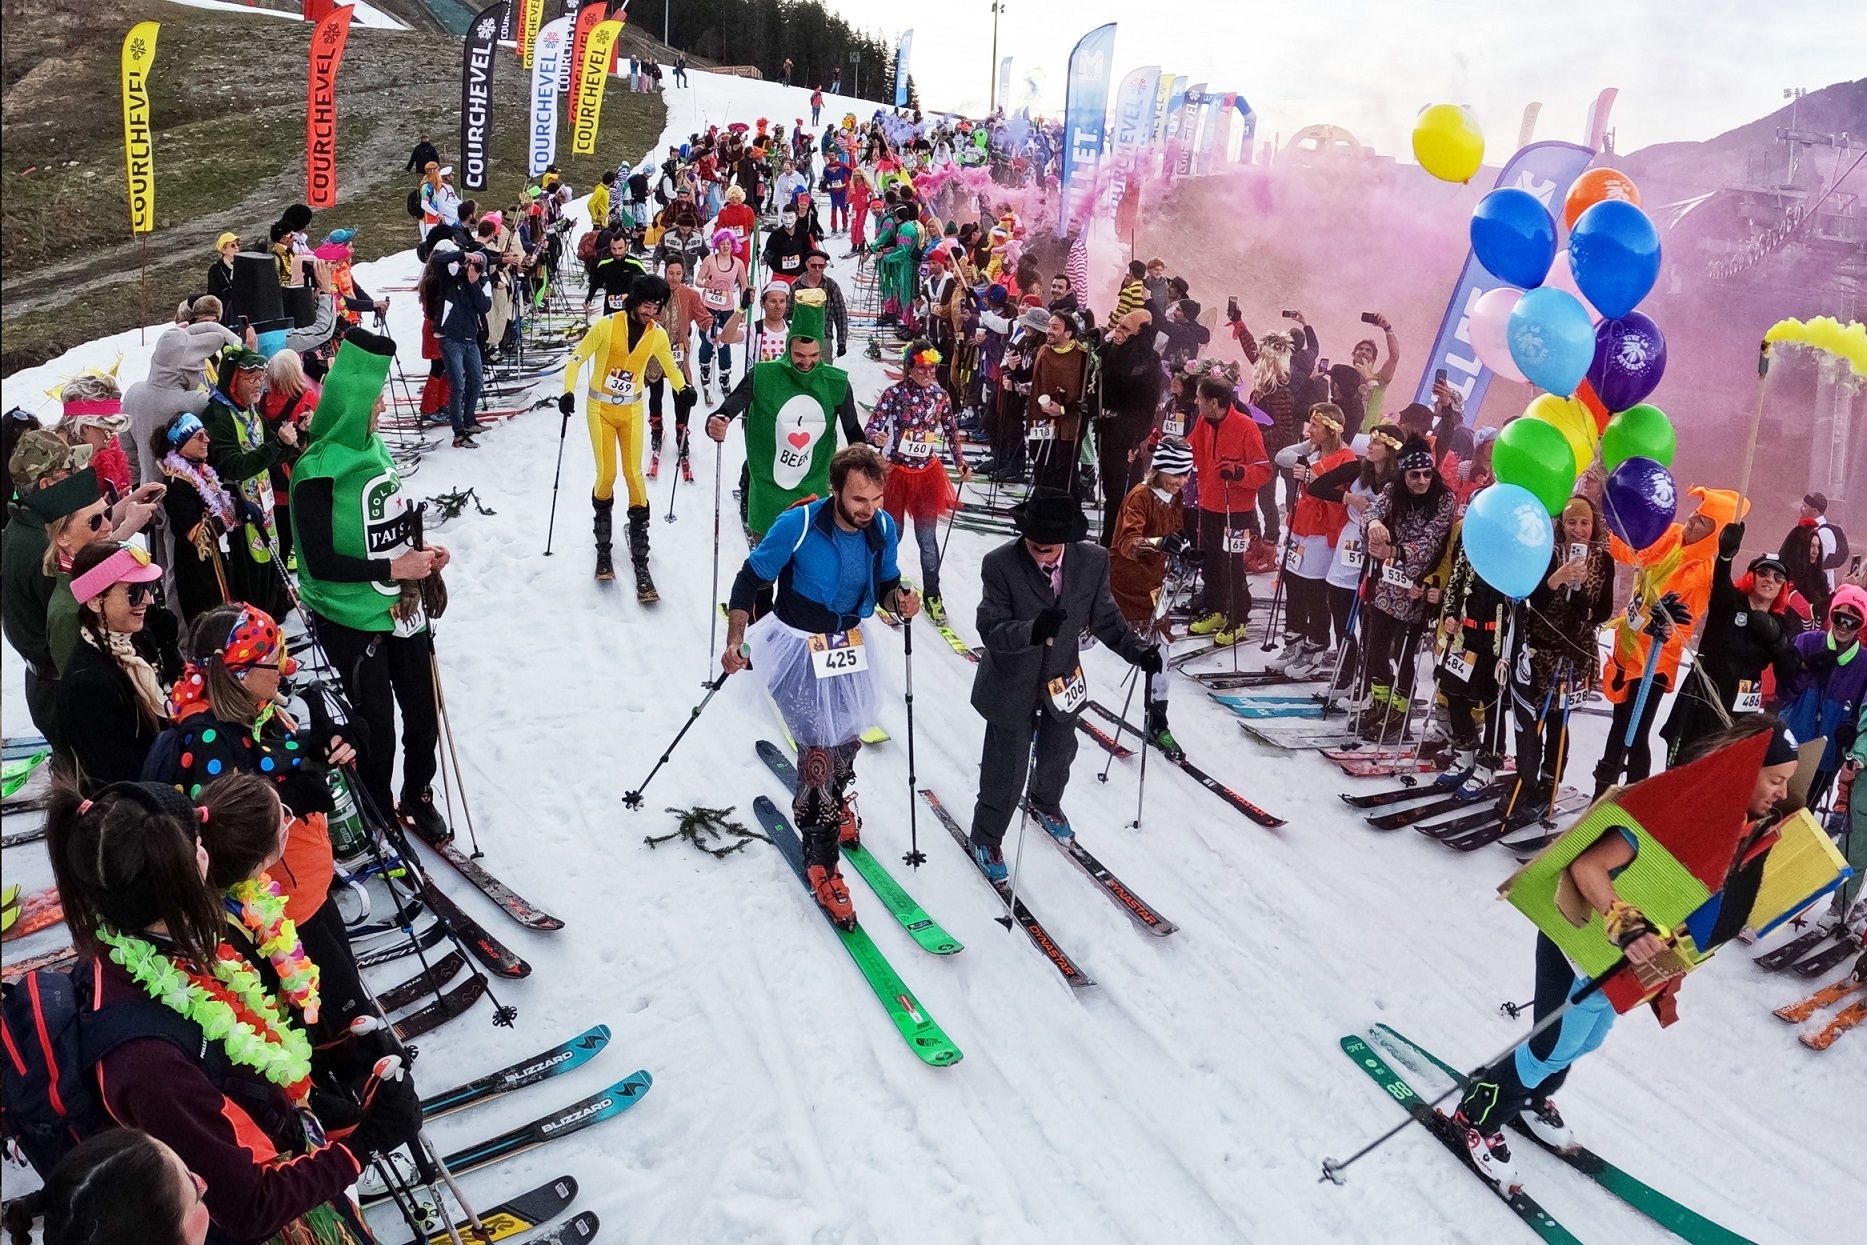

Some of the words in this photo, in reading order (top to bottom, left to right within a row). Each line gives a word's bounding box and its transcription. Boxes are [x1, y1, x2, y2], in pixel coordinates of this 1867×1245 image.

[577, 48, 607, 151] COURCHEVEL
[466, 42, 493, 188] COURCHEVEL
[533, 52, 558, 174] COURCHEVEL
[312, 47, 336, 203] COURCHEVEL
[611, 379, 632, 393] 369
[1165, 422, 1178, 432] 621
[908, 443, 927, 454] 160
[1387, 569, 1407, 585] 535
[826, 649, 857, 669] 425
[1064, 680, 1084, 707] 206
[1568, 689, 1588, 706] 528
[1741, 694, 1761, 708] 486
[1027, 924, 1076, 977] DYNASTAR
[505, 1050, 574, 1084] BLIZZARD
[1386, 1081, 1414, 1100] 88
[541, 1098, 614, 1134] BLIZZARD
